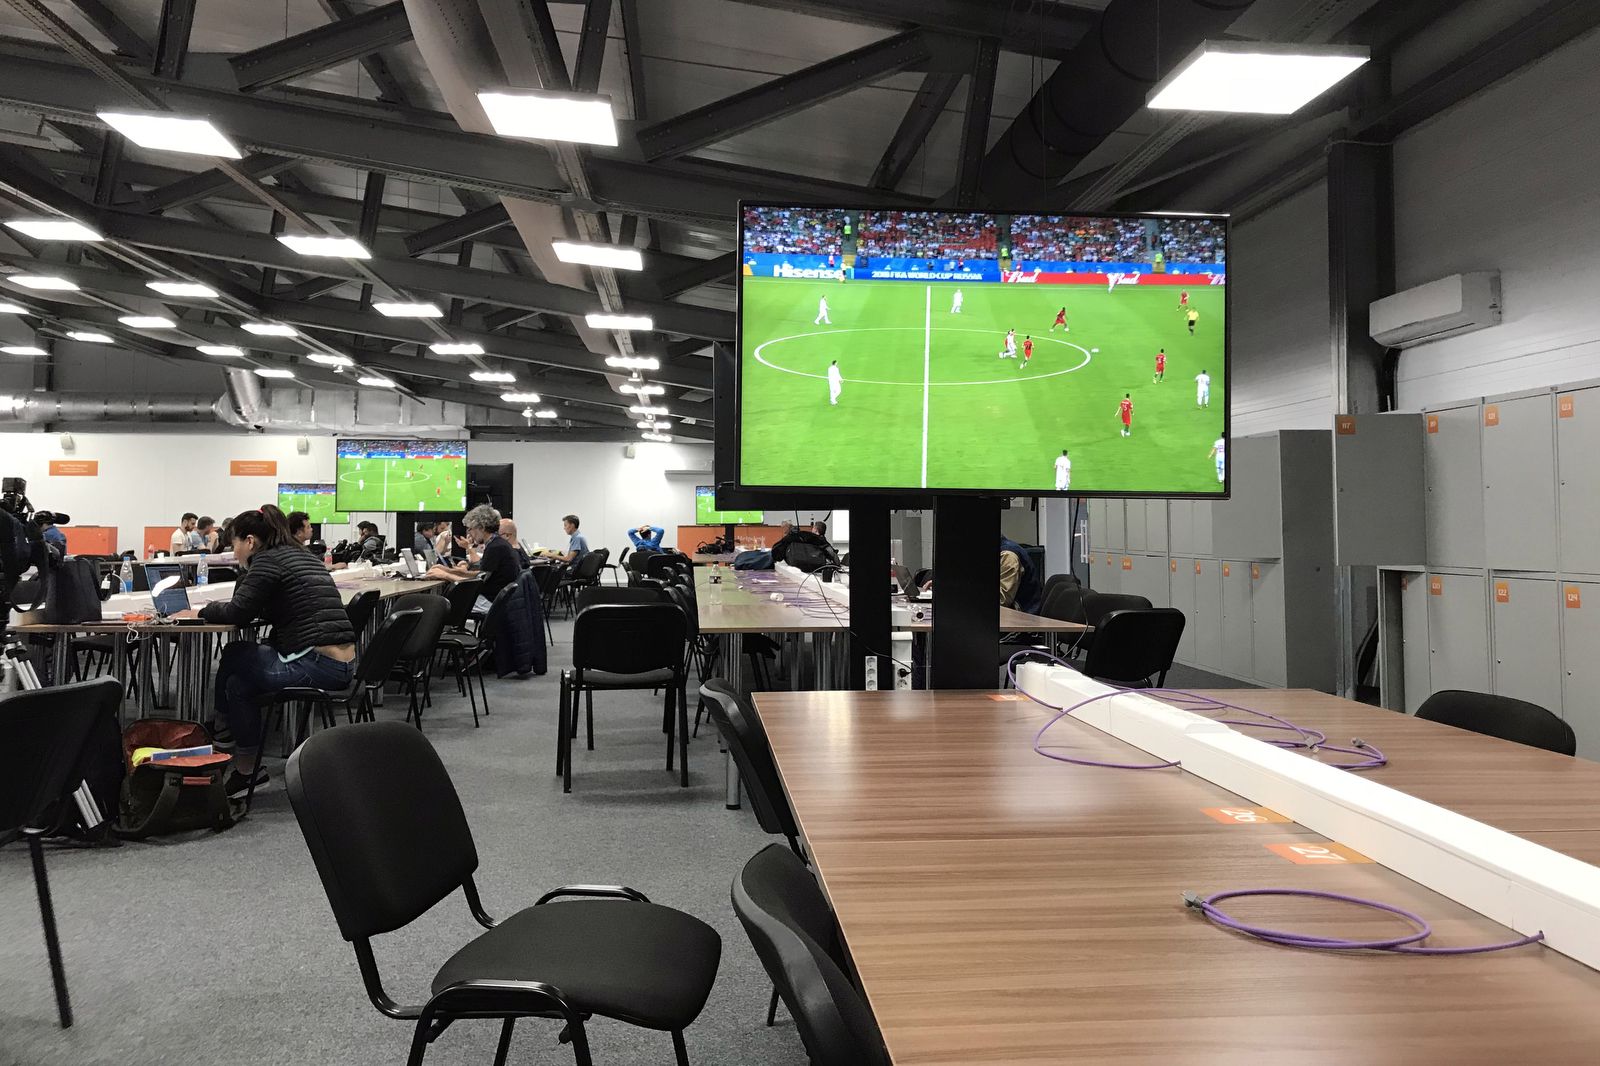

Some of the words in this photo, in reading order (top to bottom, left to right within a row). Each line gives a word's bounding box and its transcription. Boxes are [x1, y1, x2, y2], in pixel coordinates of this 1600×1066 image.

[773, 264, 844, 279] Hisense
[1219, 807, 1268, 823] 26
[1289, 845, 1348, 861] 27
